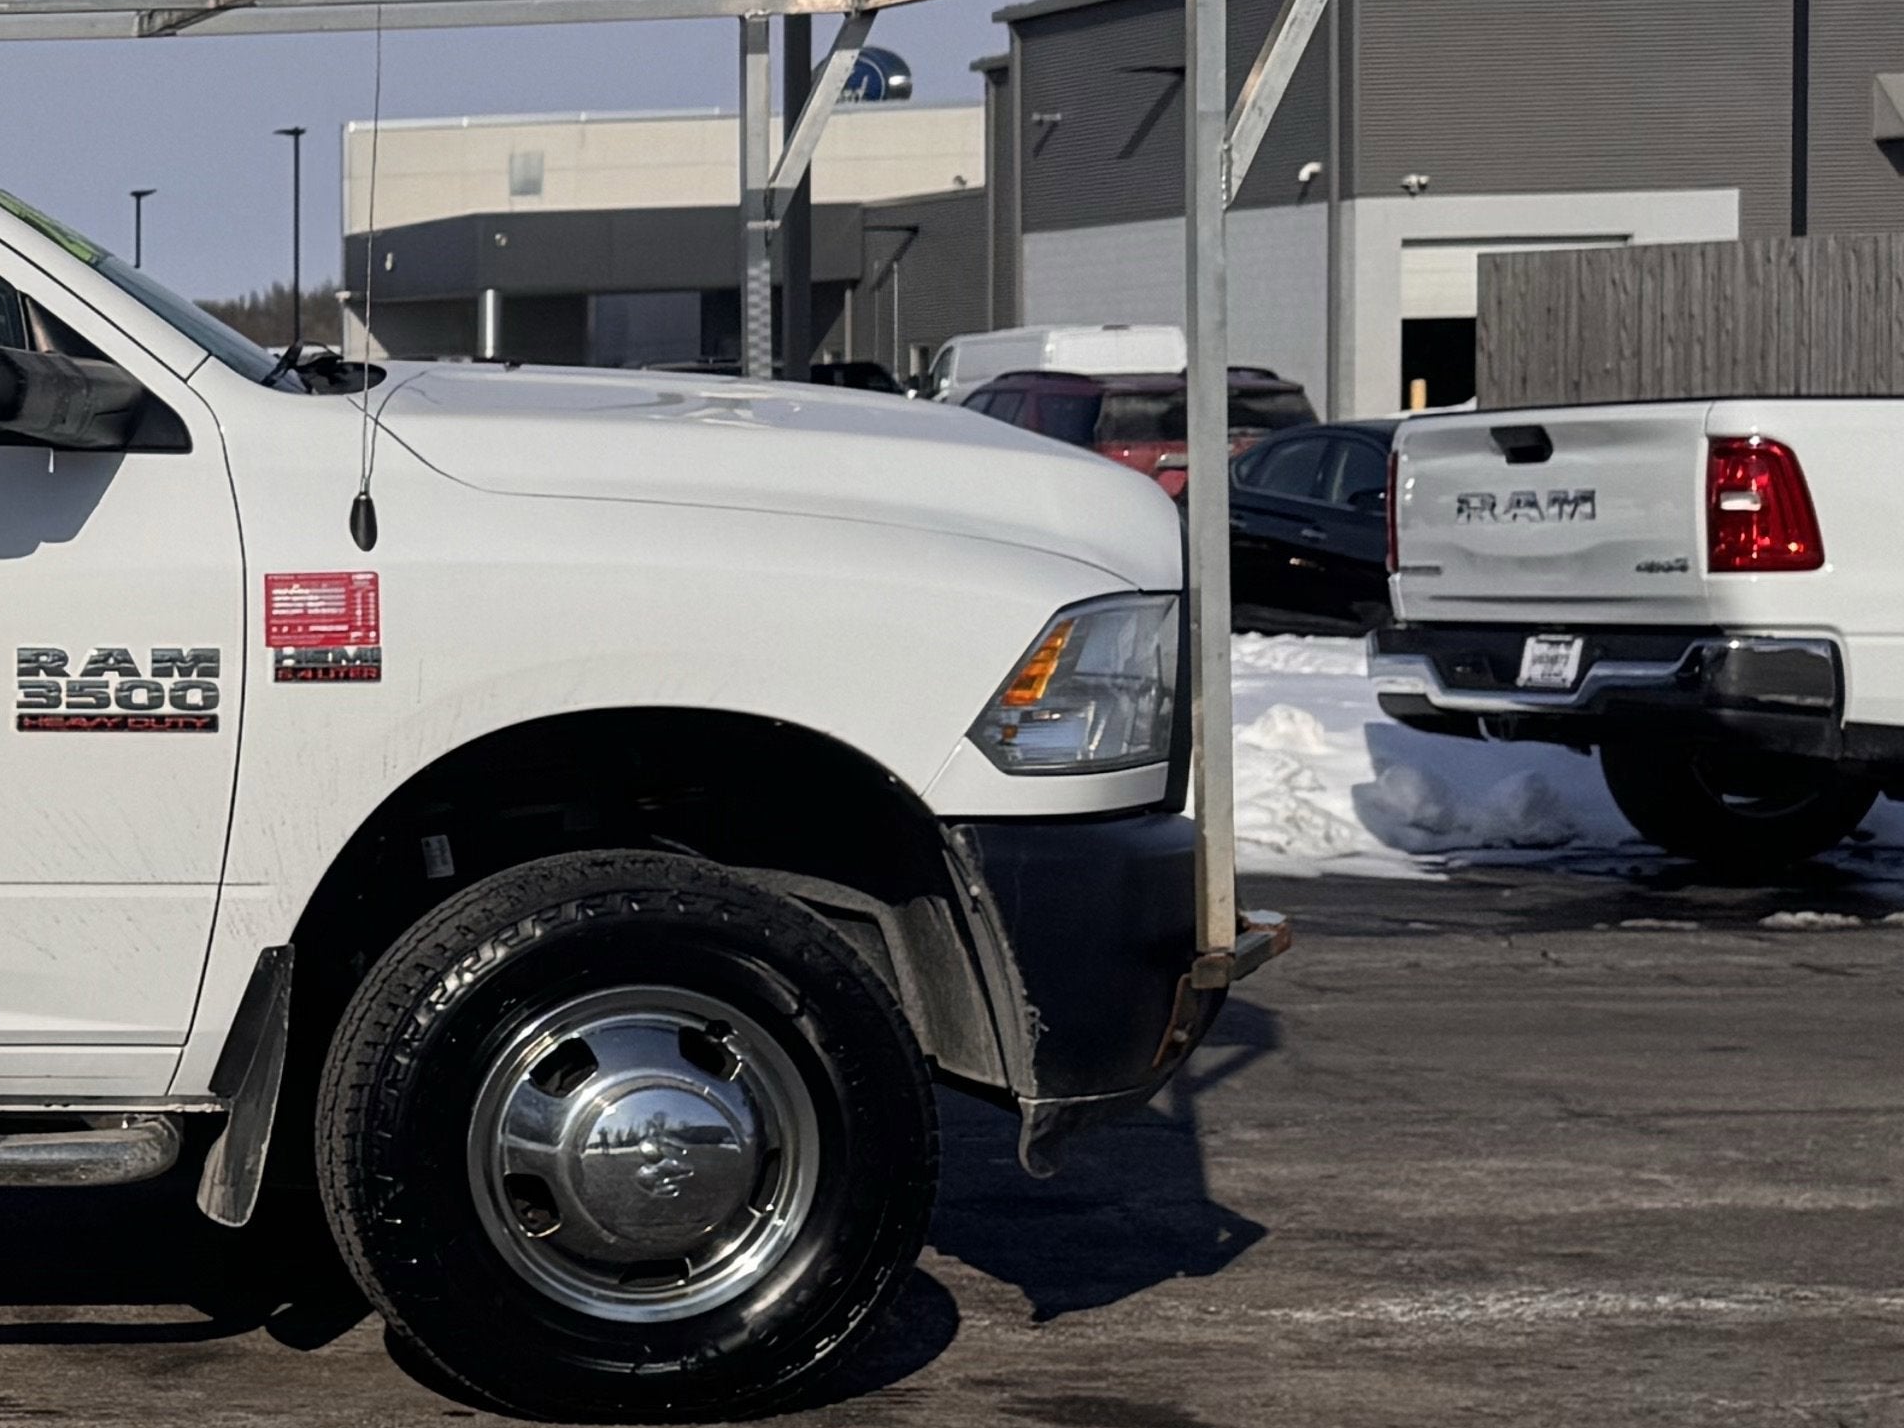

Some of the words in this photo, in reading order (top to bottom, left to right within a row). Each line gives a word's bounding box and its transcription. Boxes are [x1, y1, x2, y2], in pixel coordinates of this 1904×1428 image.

[1456, 489, 1596, 522] RAM
[16, 647, 221, 678] RAM
[316, 667, 378, 679] LITER
[16, 679, 221, 711] 3500
[23, 716, 123, 728] HEAVY
[127, 716, 211, 728] DUTY
